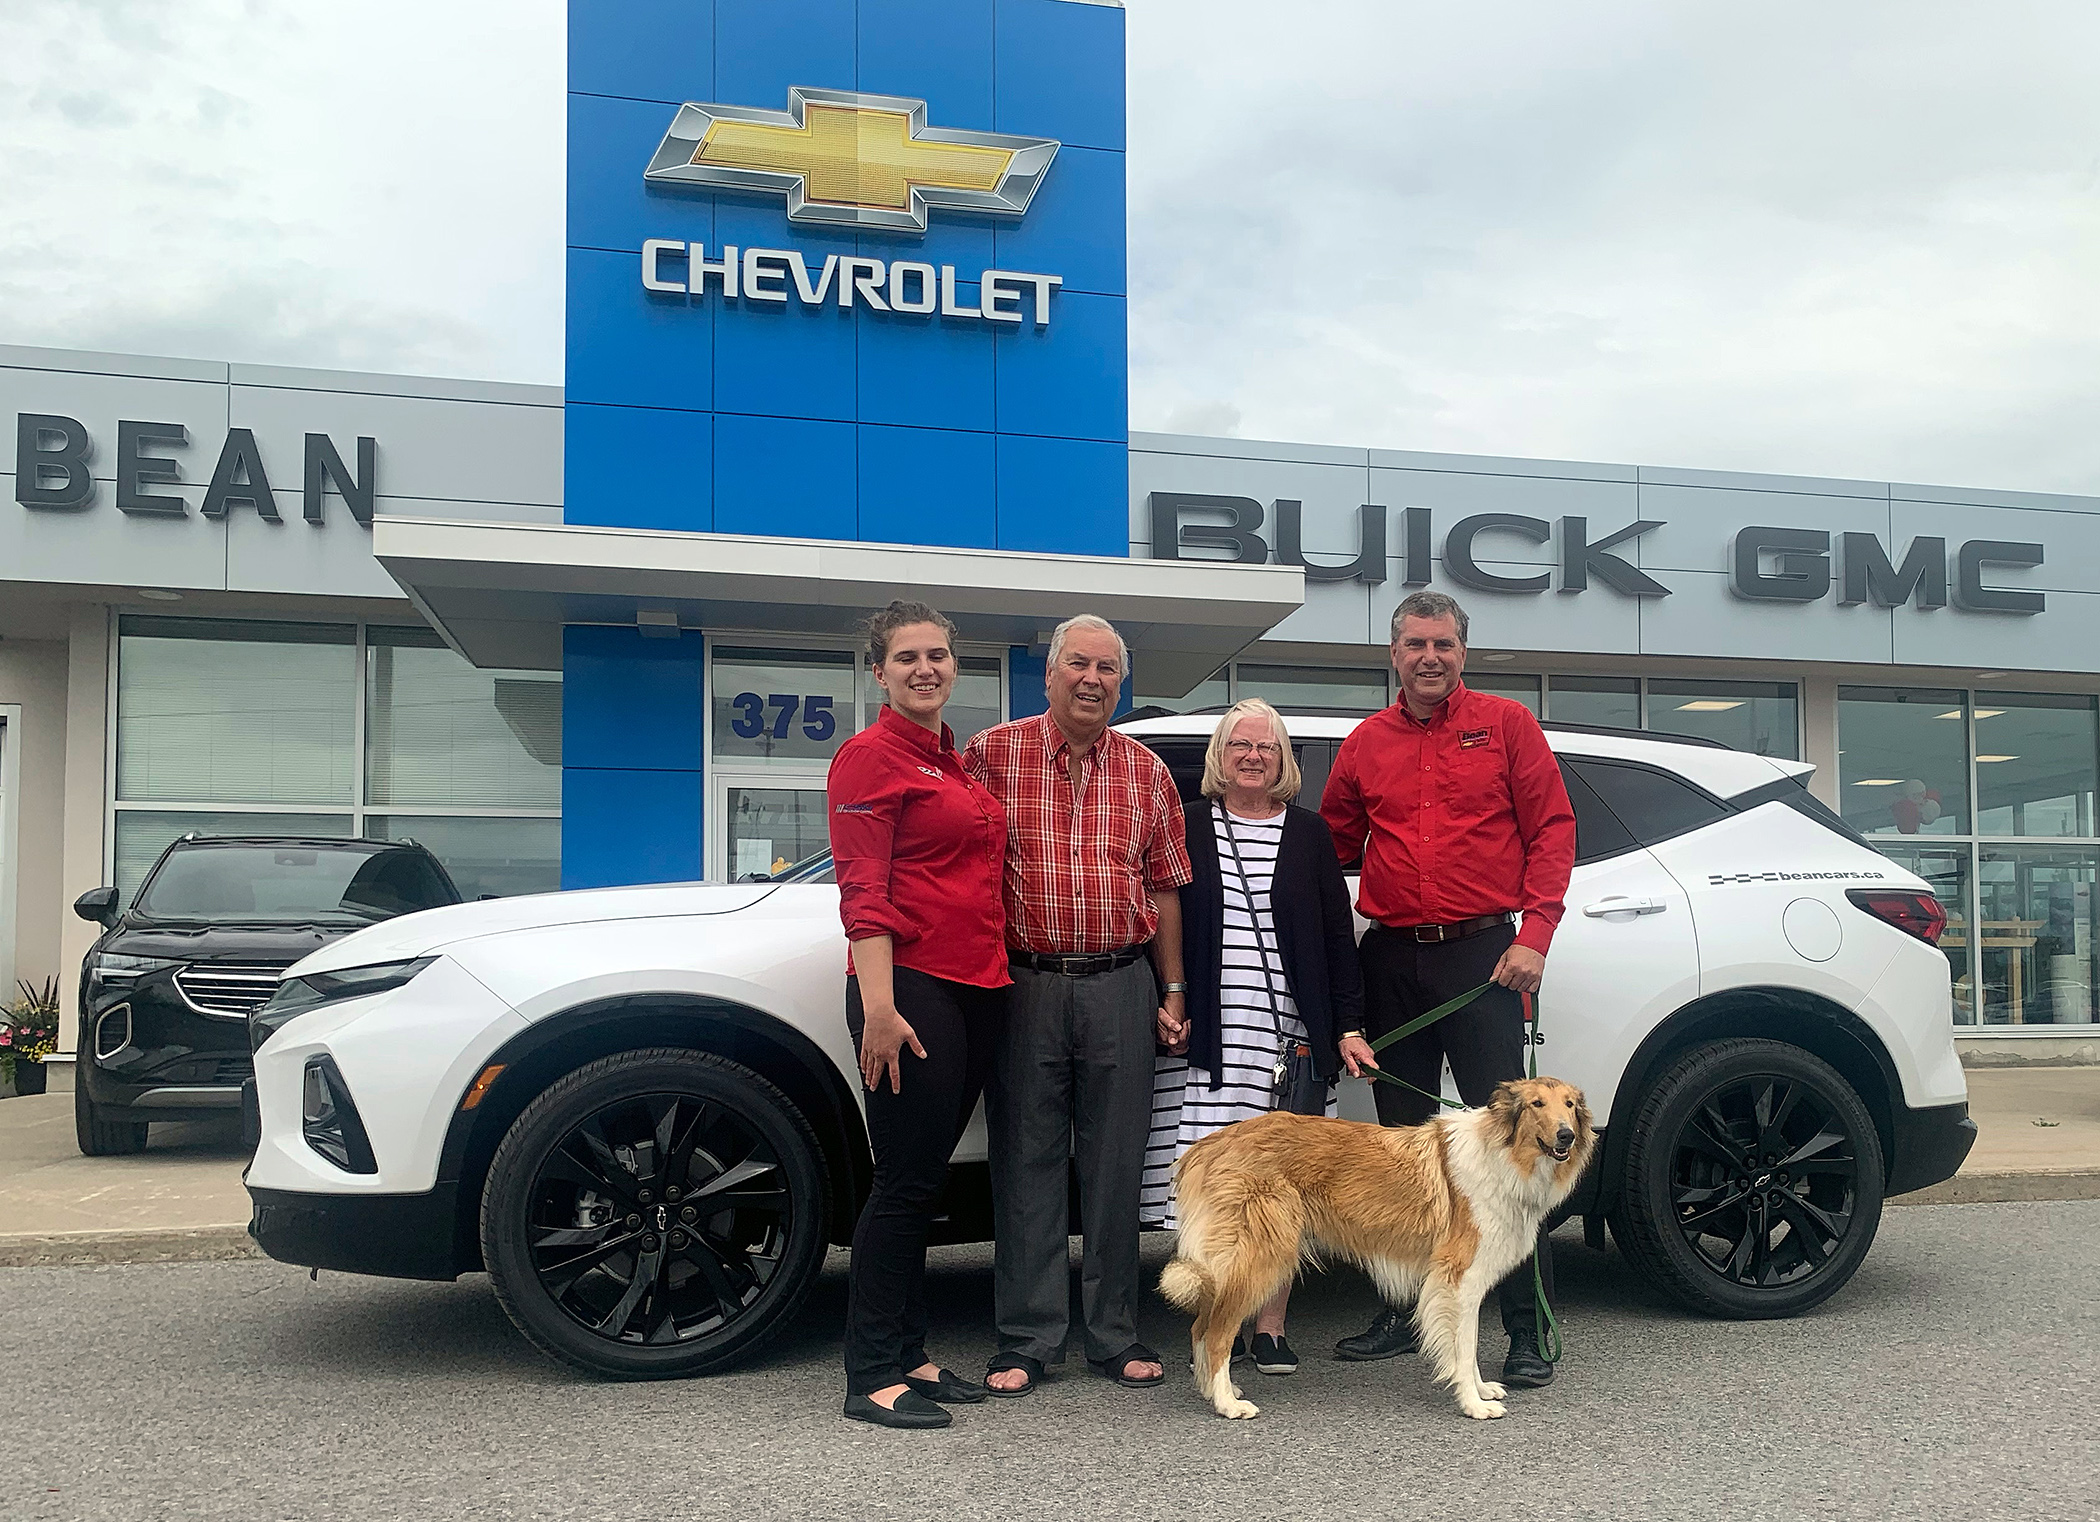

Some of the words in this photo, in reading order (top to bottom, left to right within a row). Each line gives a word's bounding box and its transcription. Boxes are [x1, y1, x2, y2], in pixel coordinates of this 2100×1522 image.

[642, 238, 1063, 325] CHEVROLET
[15, 412, 377, 527] BEAN
[1148, 490, 1673, 599] BUICK
[1727, 525, 2046, 616] GMC
[731, 692, 836, 741] 375
[1778, 871, 1885, 881] beancars.ca
